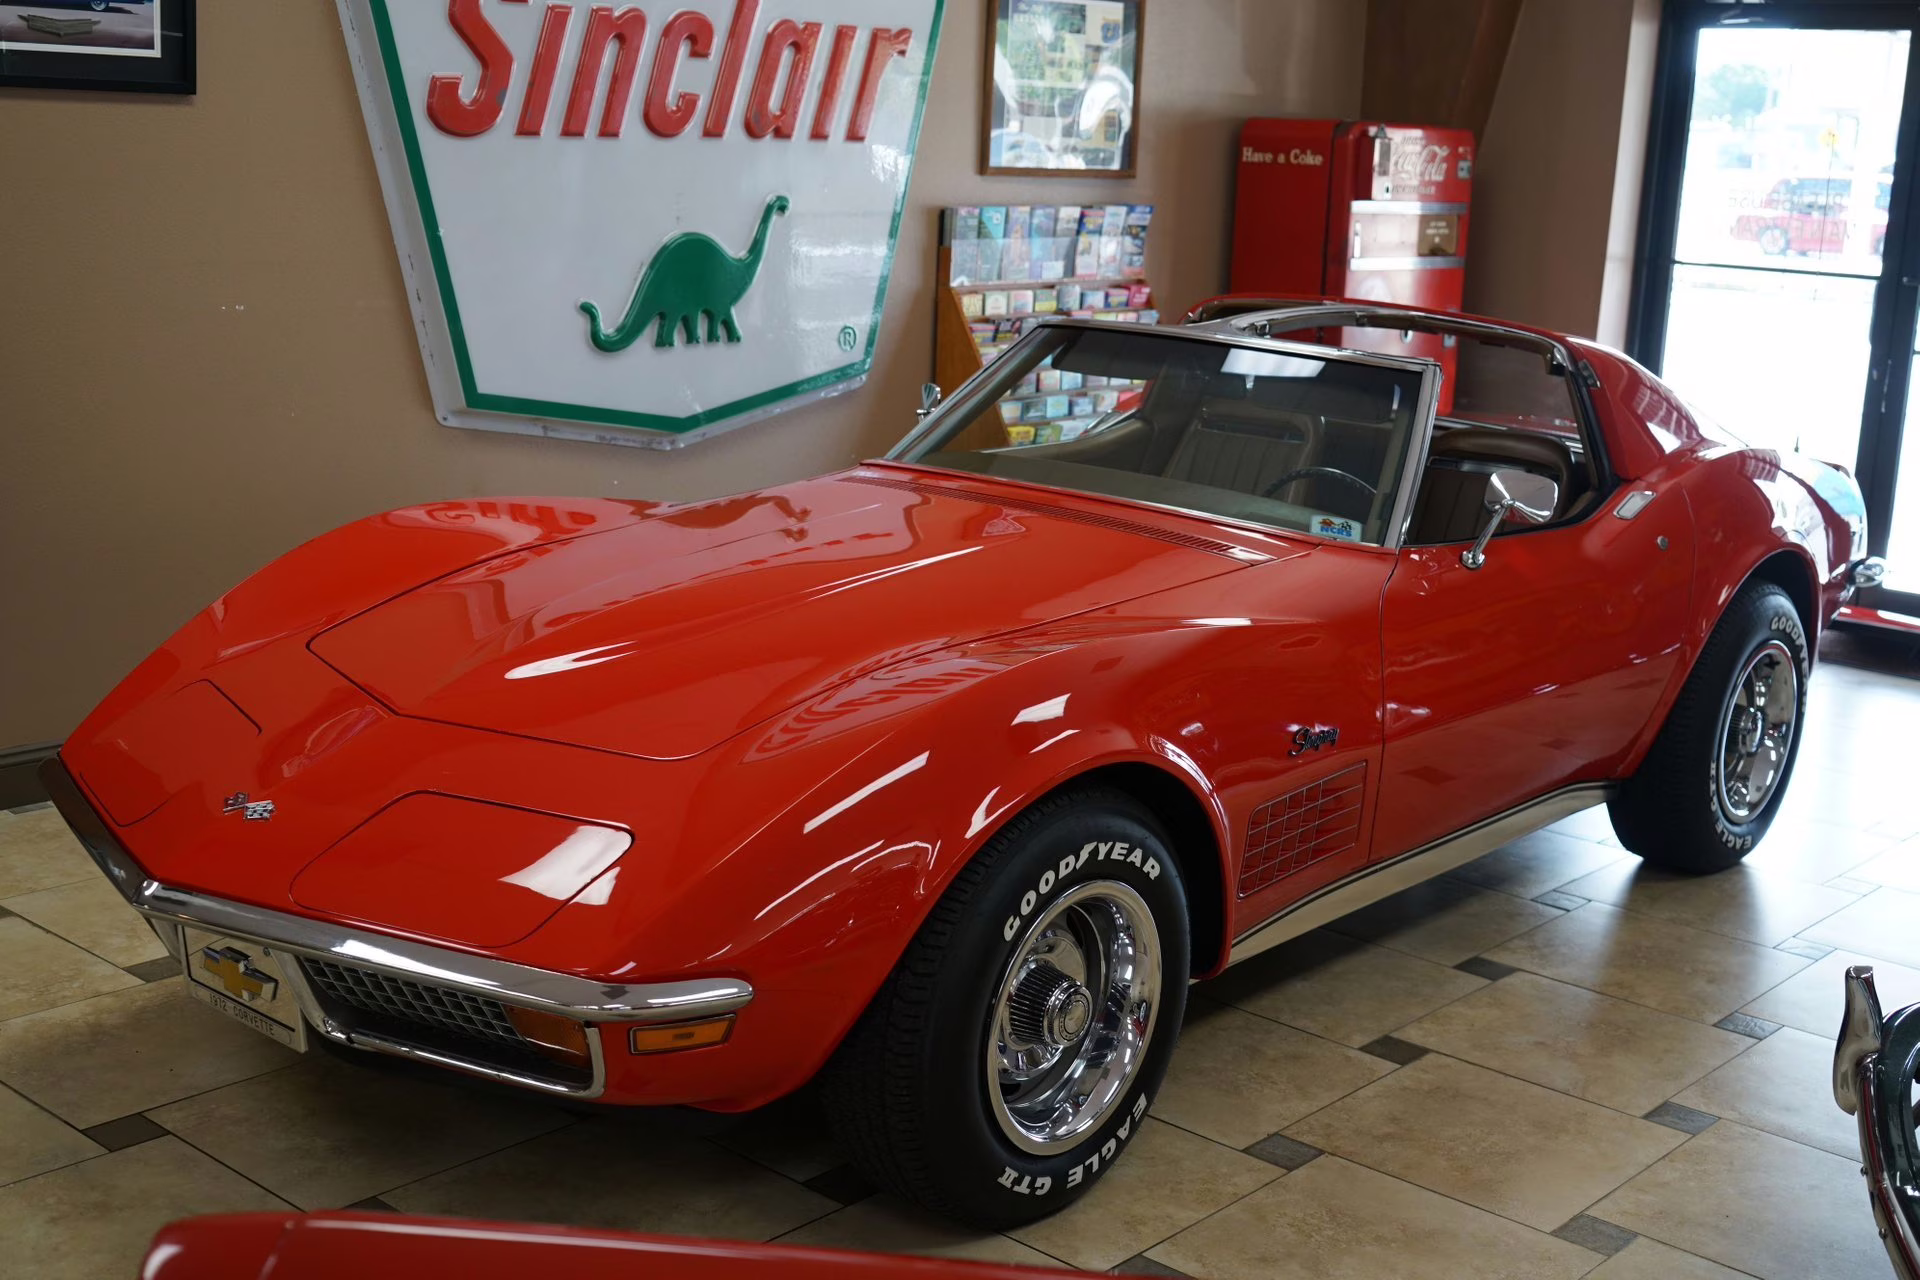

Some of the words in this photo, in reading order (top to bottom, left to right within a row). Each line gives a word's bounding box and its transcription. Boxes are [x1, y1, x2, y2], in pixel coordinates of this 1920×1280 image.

[426, 0, 913, 142] Sinclair
[1242, 147, 1274, 164] Have
[1277, 153, 1287, 163] a
[1289, 149, 1324, 167] Coke
[1320, 526, 1352, 537] NCRS
[1714, 820, 1753, 850] EAGLE
[1003, 841, 1162, 943] GOODYEAR
[209, 993, 229, 1013] 1972
[232, 1005, 275, 1036] CORVETTE
[1065, 1092, 1148, 1190] EAGLE
